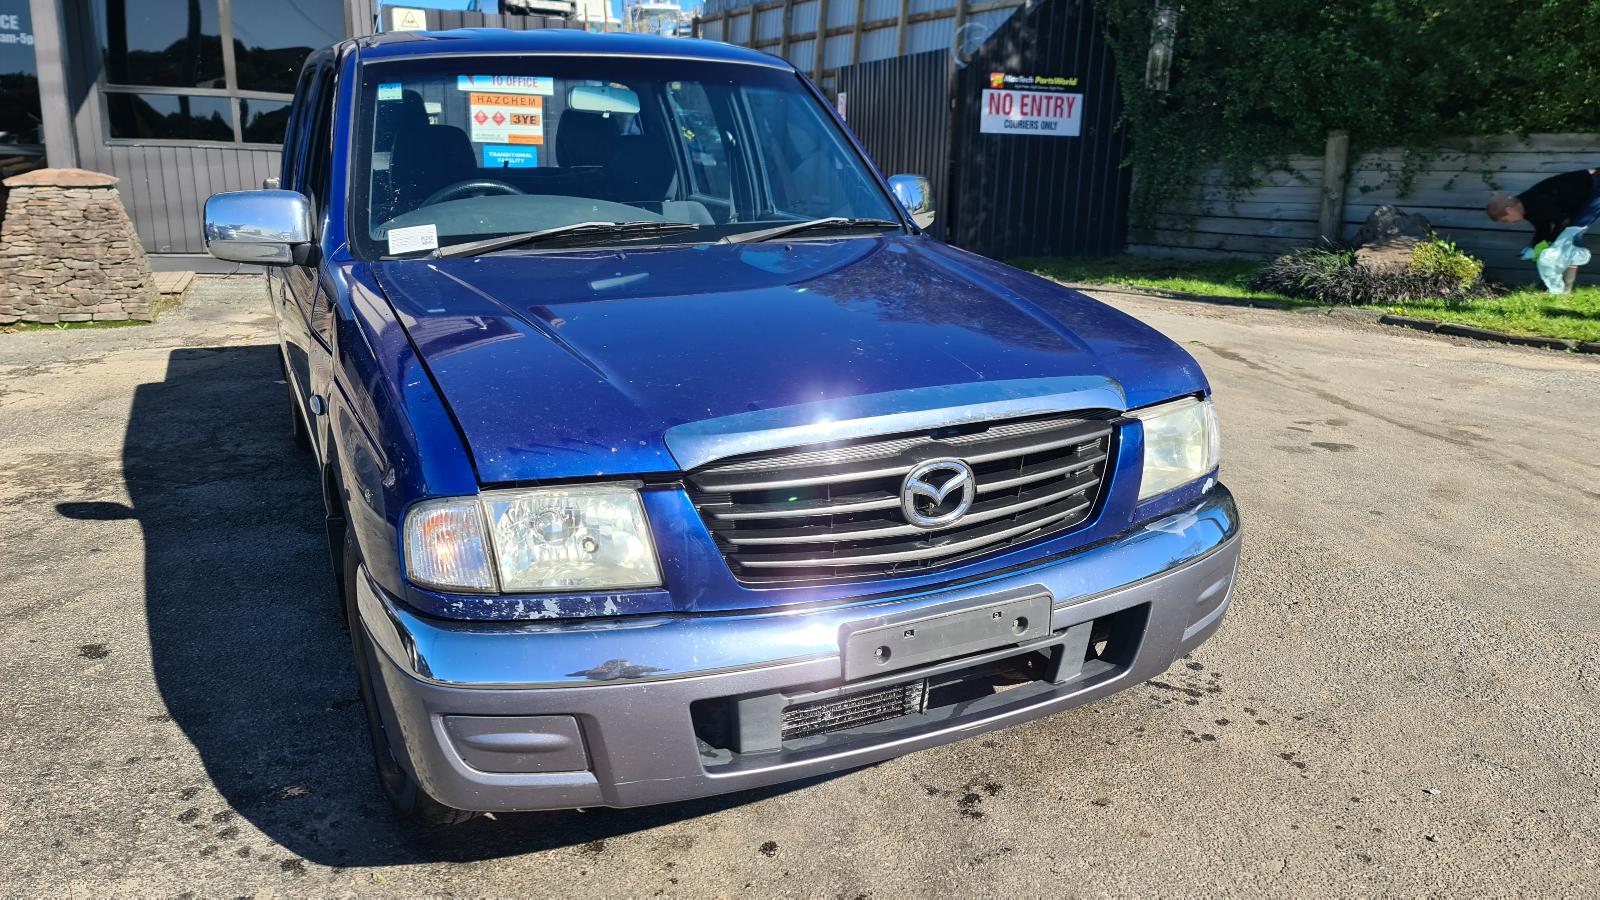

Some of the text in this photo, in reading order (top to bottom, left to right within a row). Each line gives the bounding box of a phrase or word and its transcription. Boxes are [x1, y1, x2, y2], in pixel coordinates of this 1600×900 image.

[506, 76, 538, 88] OFFICE
[477, 95, 536, 106] HAZCHEM
[988, 92, 1076, 119] NO ENTRY
[513, 114, 537, 125] 3YE
[1004, 119, 1058, 130] COURIERS ONLY
